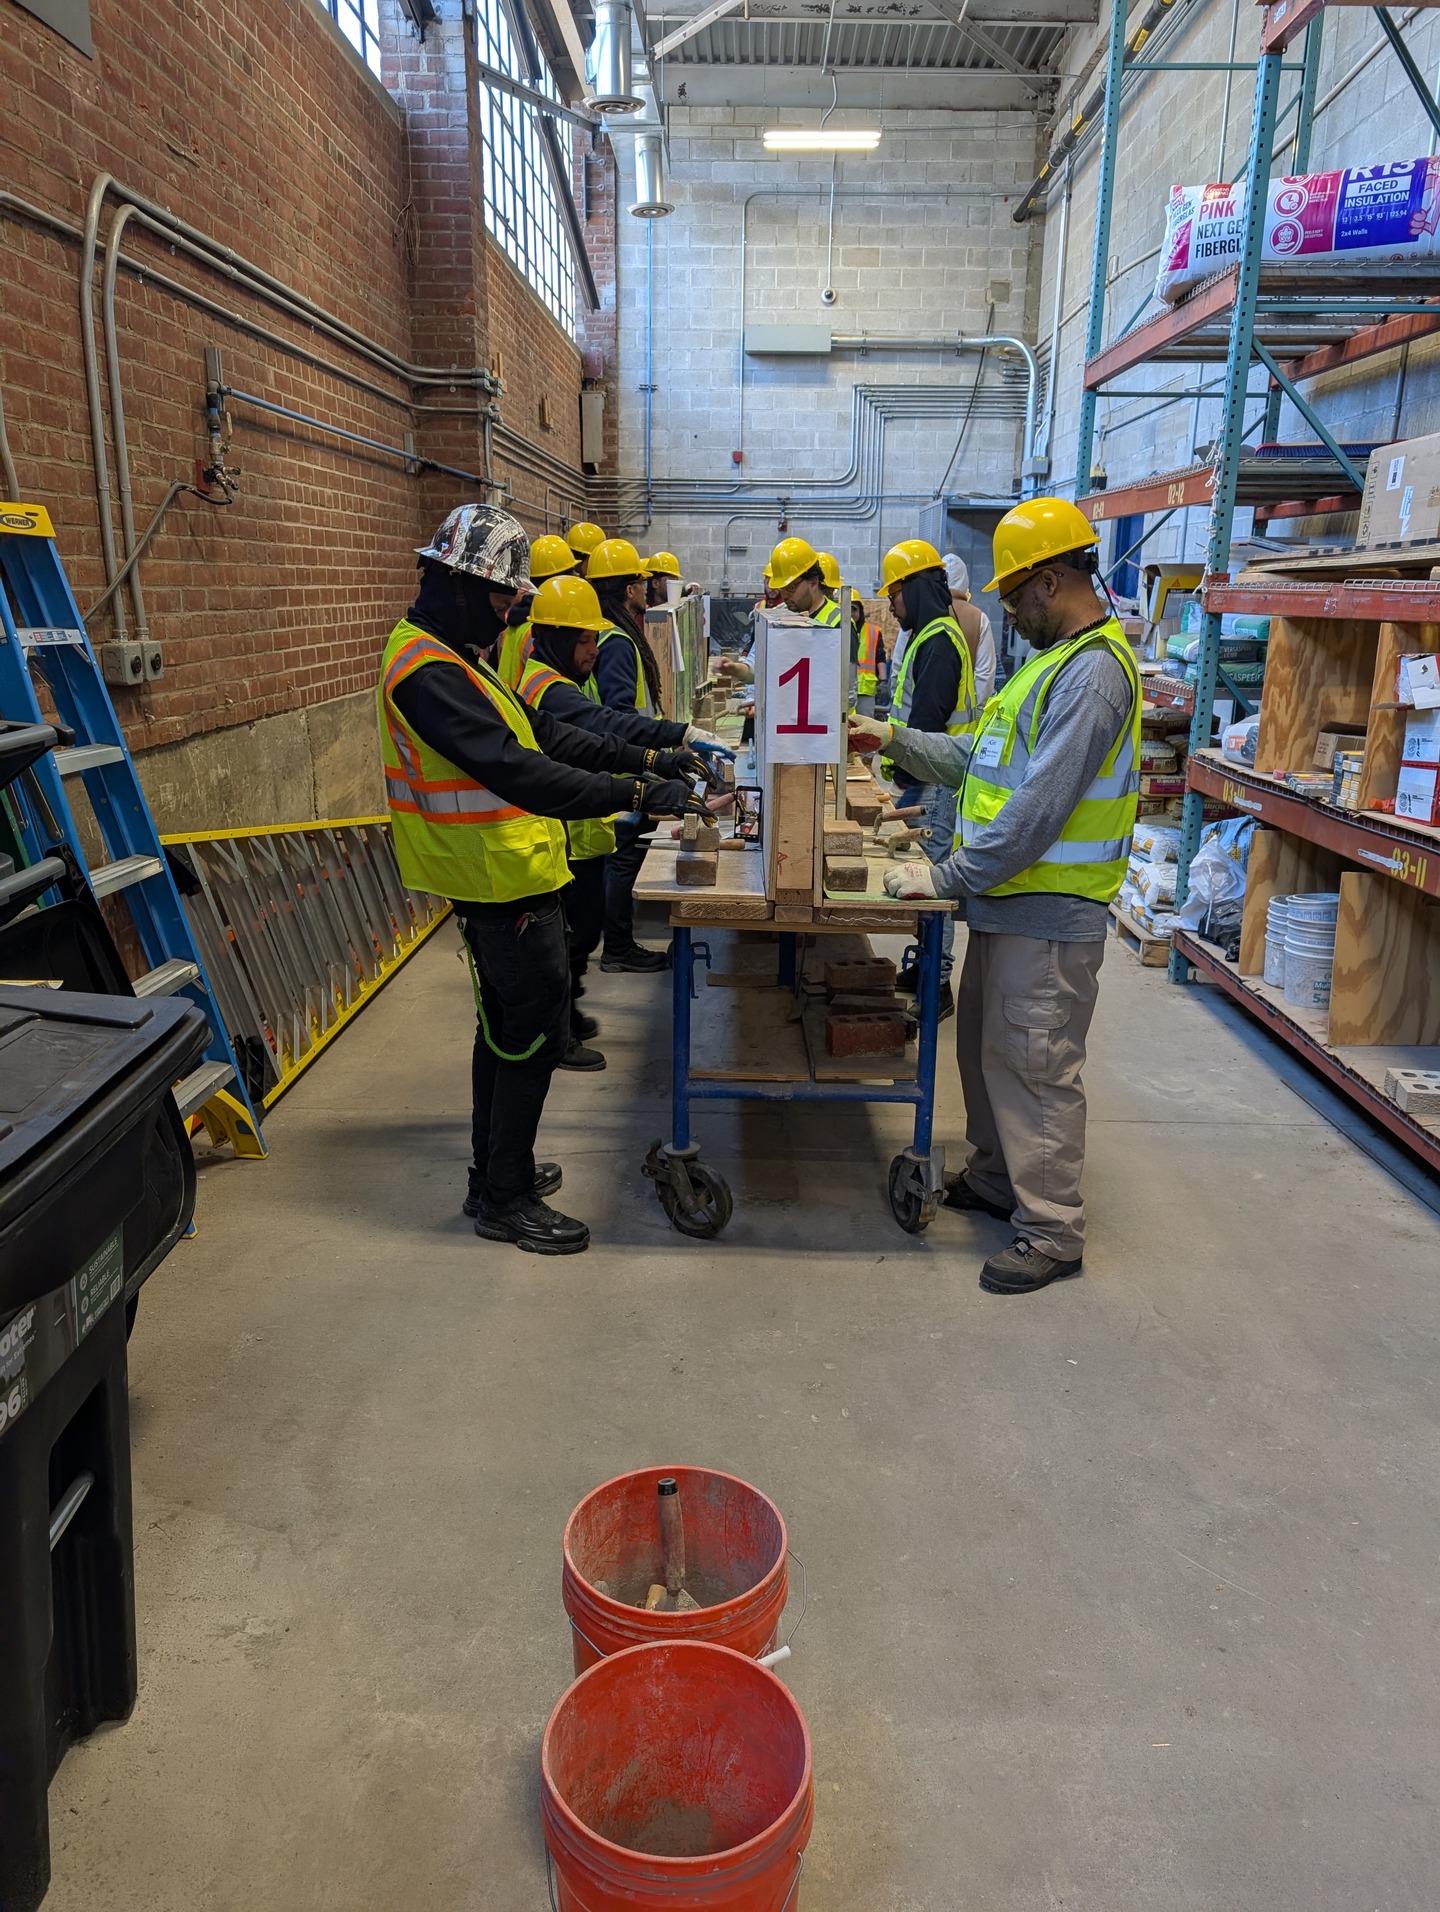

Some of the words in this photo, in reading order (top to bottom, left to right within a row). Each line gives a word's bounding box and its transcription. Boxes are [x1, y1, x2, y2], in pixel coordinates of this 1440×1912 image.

[1359, 180, 1398, 194] FACED
[1344, 191, 1410, 208] INSULATION
[1199, 200, 1236, 222] PINK
[1197, 222, 1224, 240] NEXT
[1227, 219, 1243, 235] GE
[1341, 229, 1352, 237] 2x4
[1353, 228, 1368, 236] Walls
[1196, 238, 1240, 259] FIBERGL
[1168, 482, 1185, 505] 02-12
[6, 516, 30, 527] WERNER
[776, 657, 828, 735] 1
[1391, 847, 1428, 889] 03-11
[89, 1236, 118, 1275] SUSTAINABLE
[90, 1269, 110, 1298] RELIABLE
[0, 1307, 34, 1358] oter
